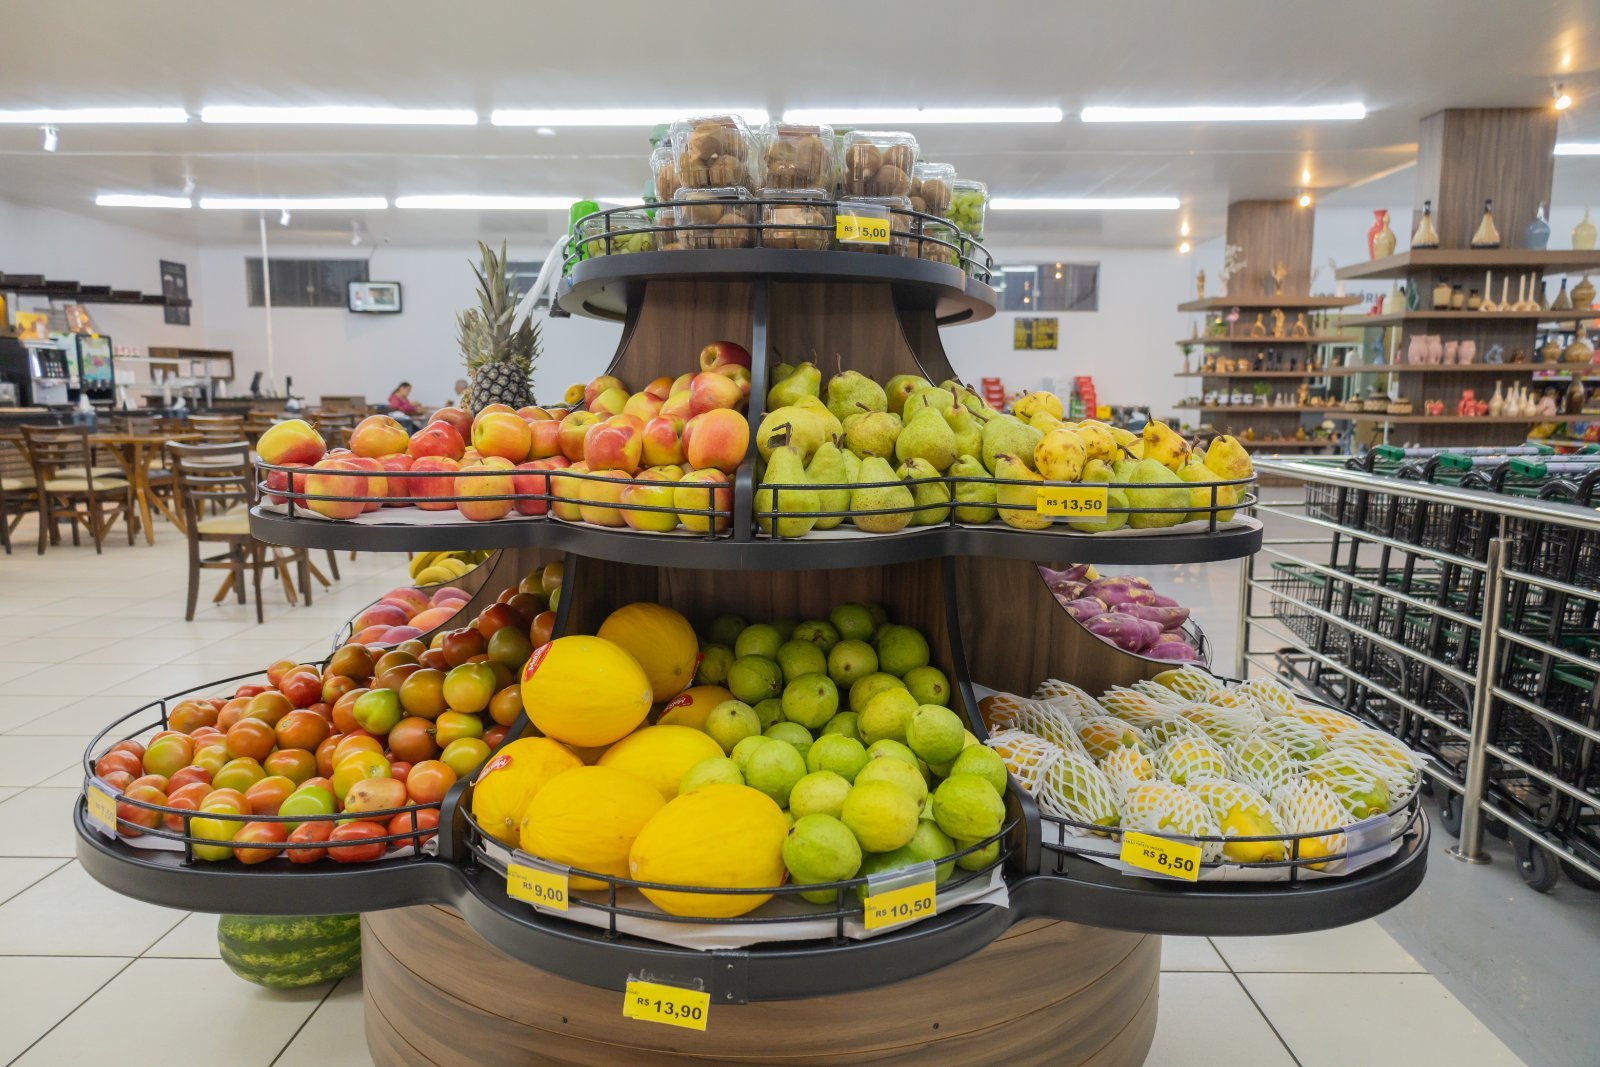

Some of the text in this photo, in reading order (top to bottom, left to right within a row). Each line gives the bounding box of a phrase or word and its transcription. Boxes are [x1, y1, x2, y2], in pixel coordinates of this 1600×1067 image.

[1061, 499, 1102, 512] 13,50
[1157, 853, 1194, 872] 8,50
[535, 884, 563, 902] 9,00
[891, 897, 932, 917] 10,50
[653, 1000, 702, 1020] 13,90
